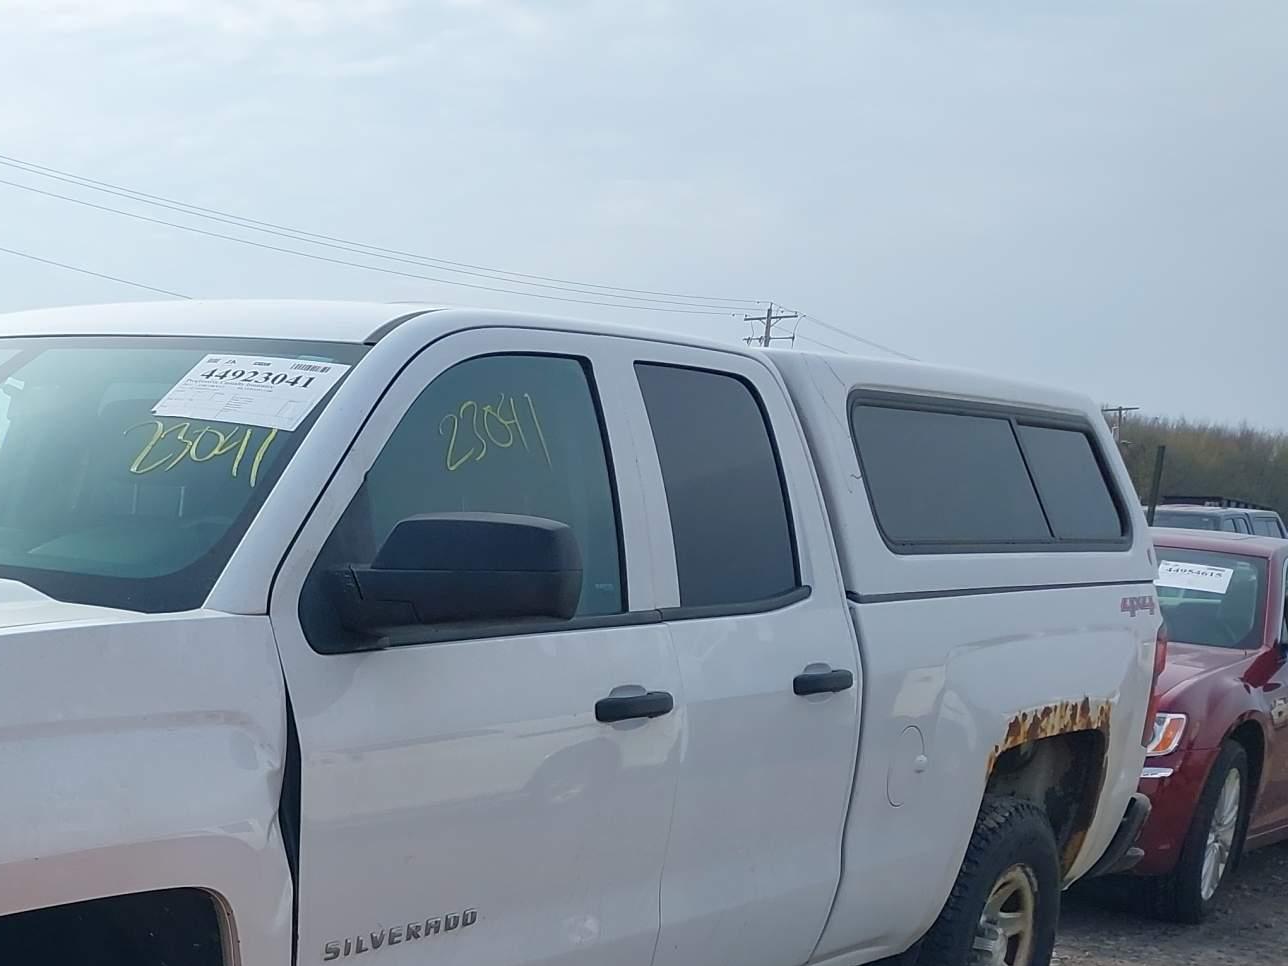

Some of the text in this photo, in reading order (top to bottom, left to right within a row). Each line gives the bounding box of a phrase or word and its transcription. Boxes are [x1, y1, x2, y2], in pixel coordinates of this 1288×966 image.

[200, 367, 316, 389] 44923041
[123, 419, 279, 488] 23041
[439, 392, 553, 471] 23041
[323, 907, 479, 962] SILVERADO
